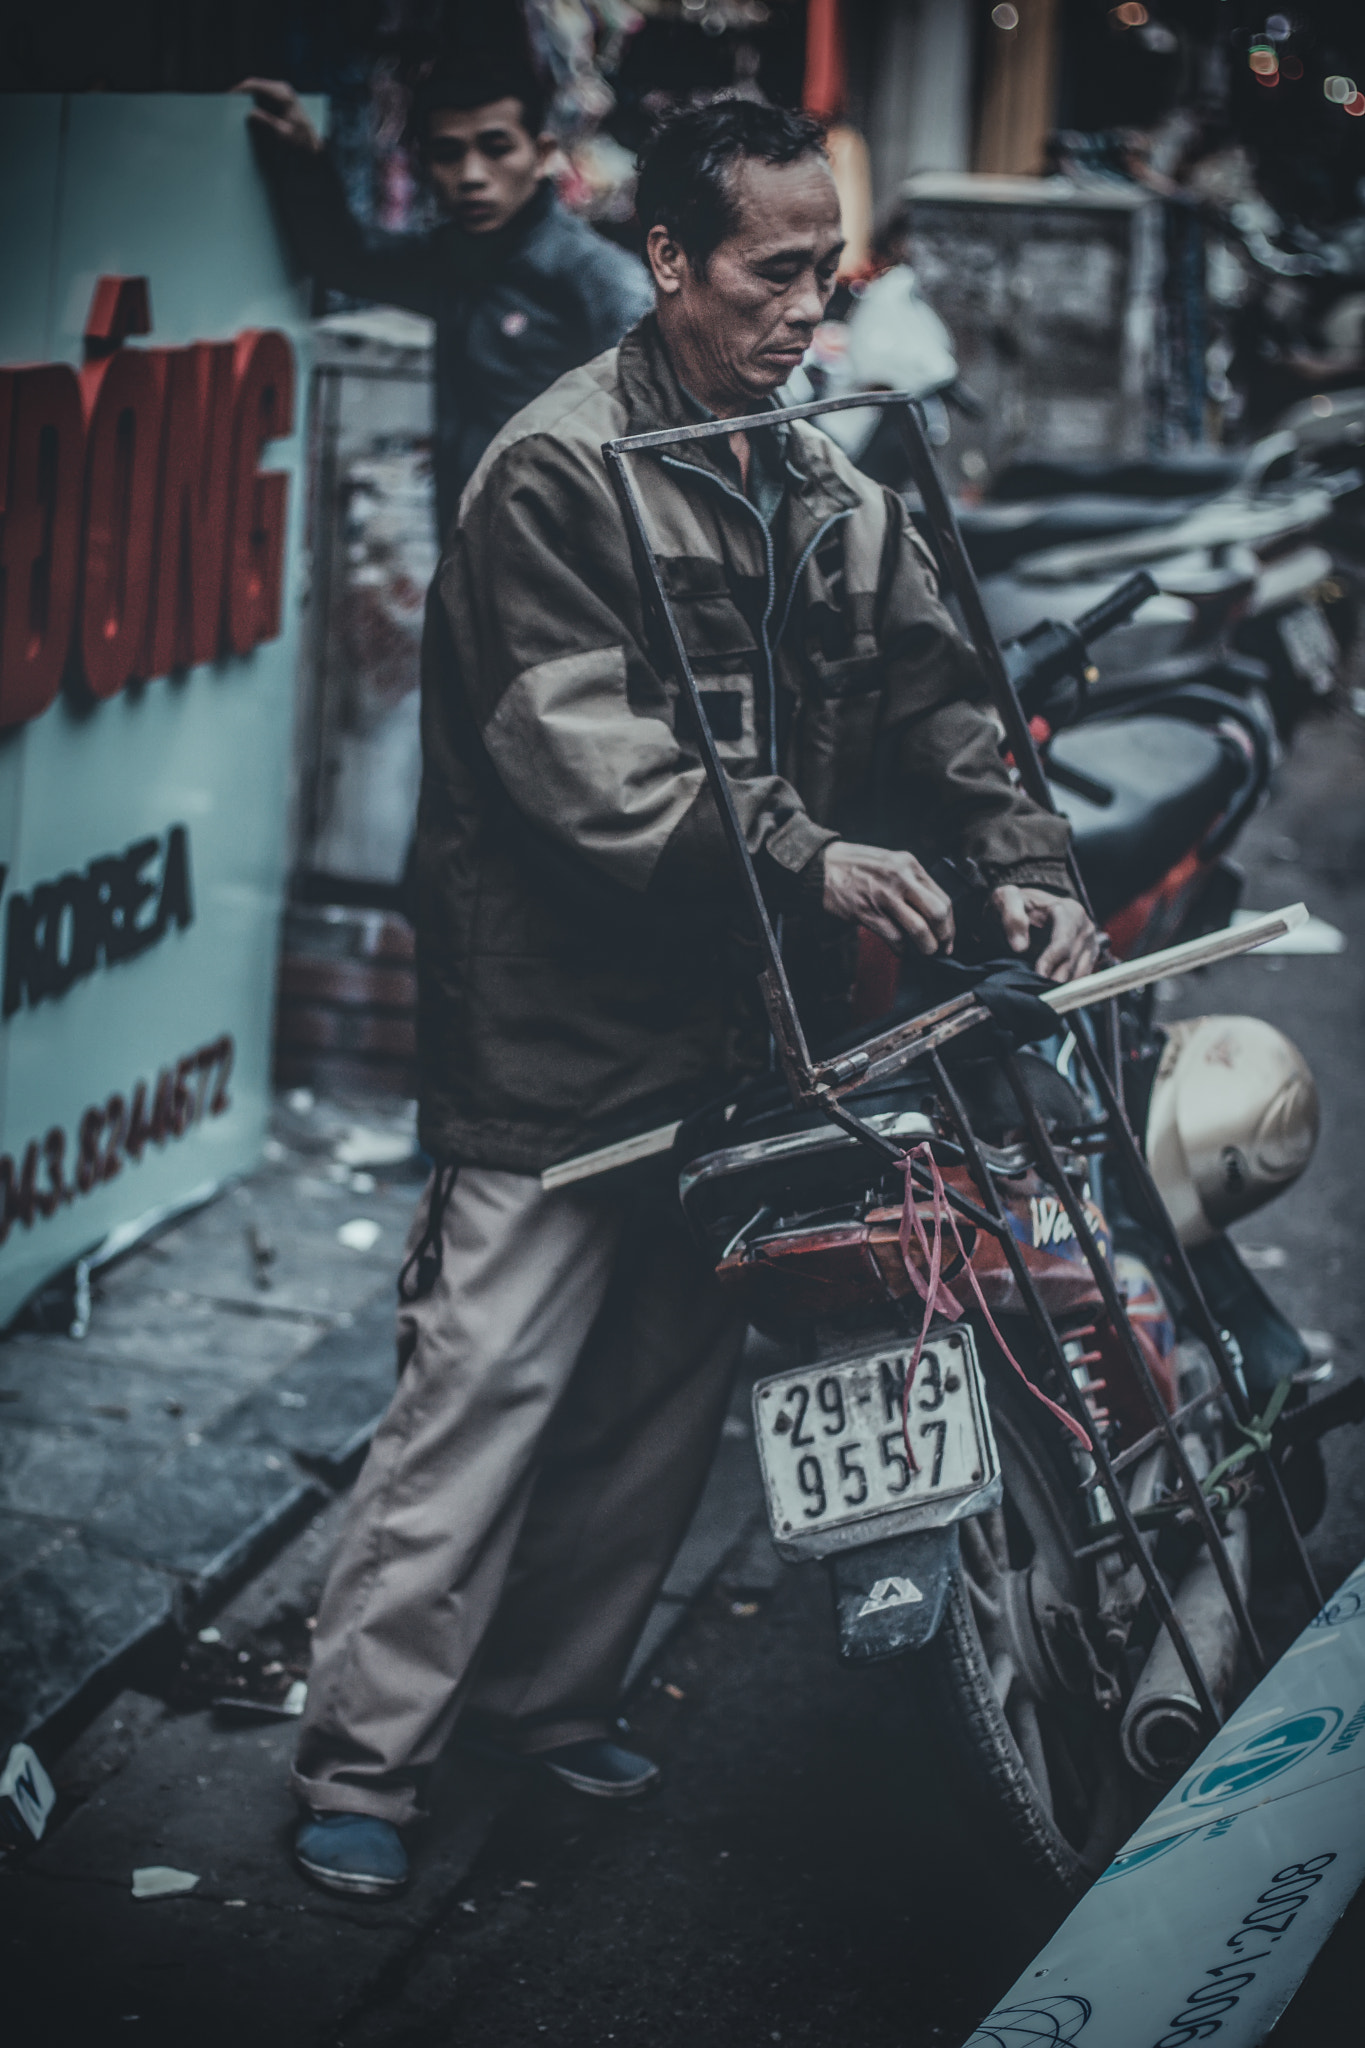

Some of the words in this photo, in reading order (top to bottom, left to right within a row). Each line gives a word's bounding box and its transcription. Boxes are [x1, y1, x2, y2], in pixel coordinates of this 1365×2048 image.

[3, 823, 194, 1020] KOREA
[797, 1419, 947, 1518] 9557
[1152, 1852, 1338, 2048] 9001:2008
